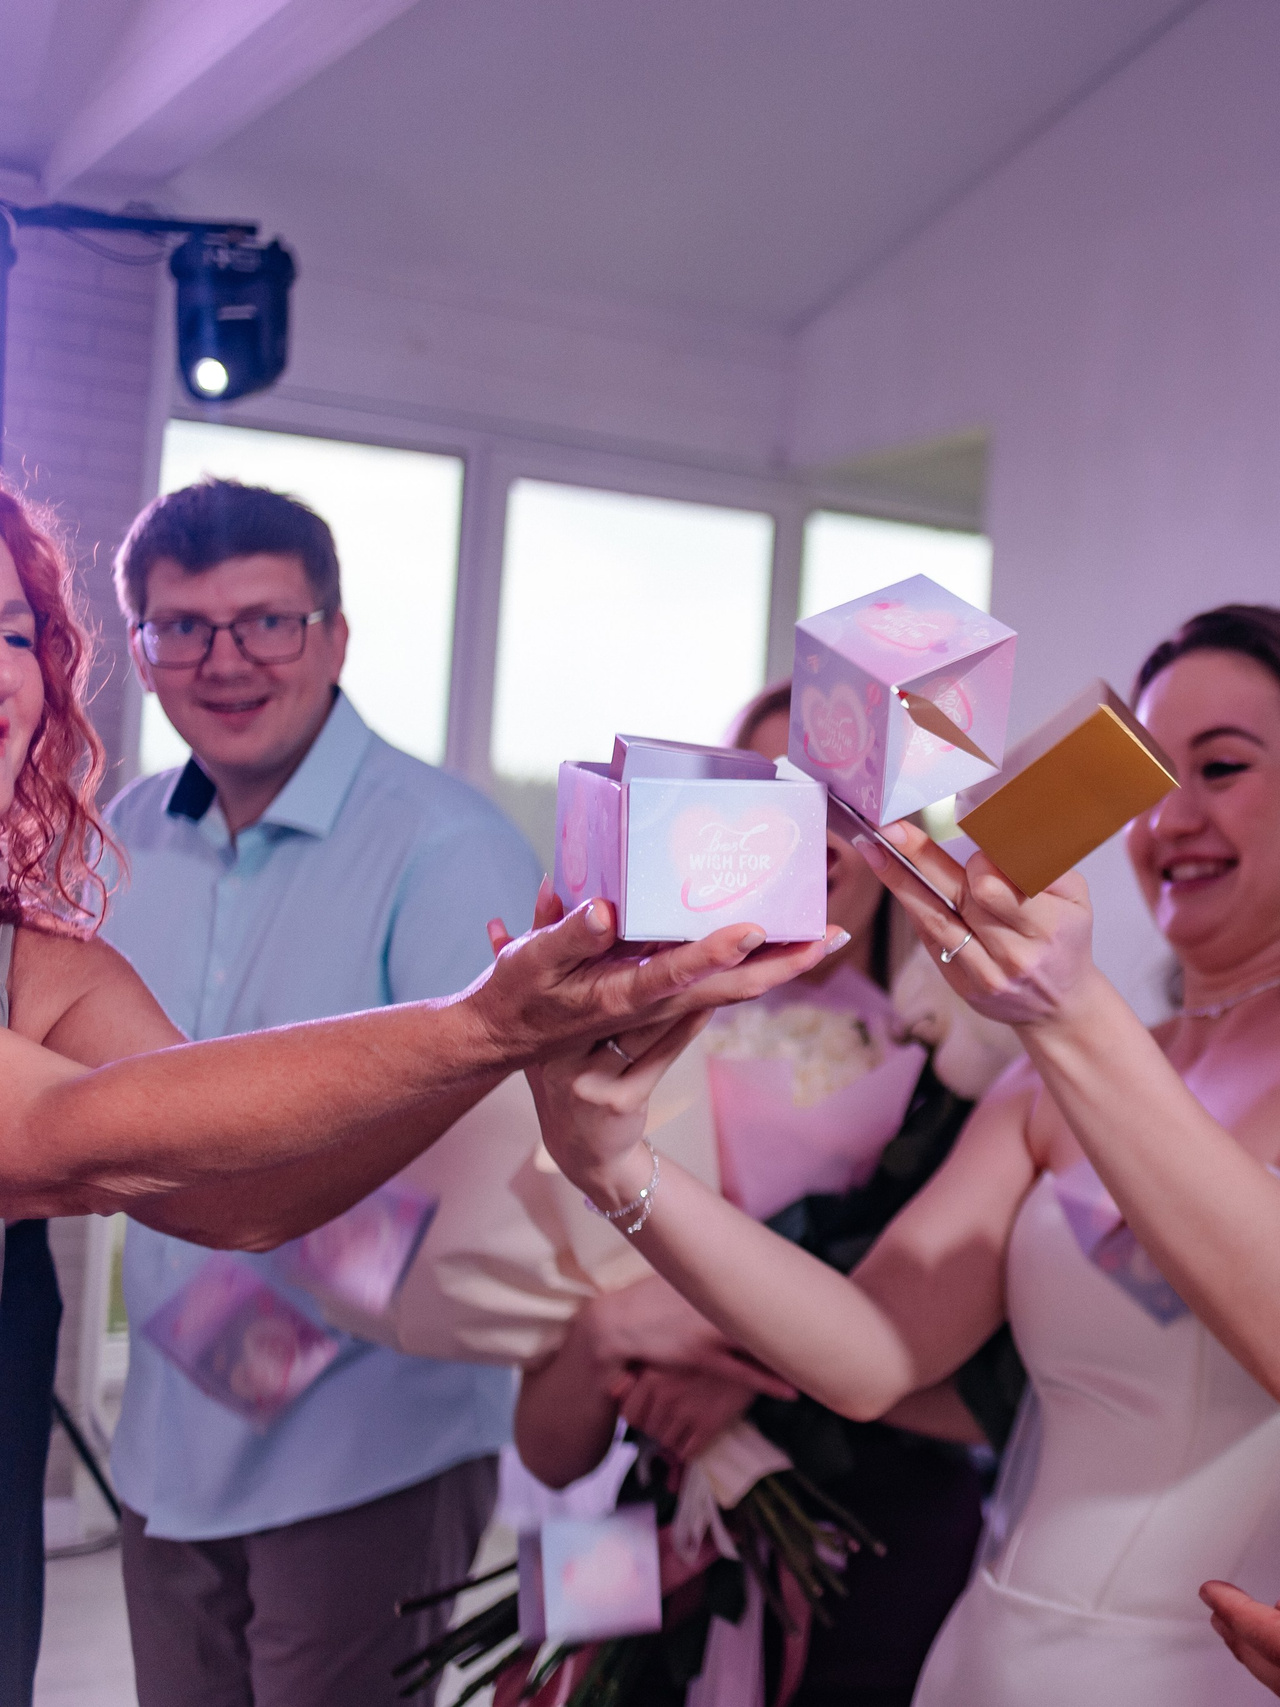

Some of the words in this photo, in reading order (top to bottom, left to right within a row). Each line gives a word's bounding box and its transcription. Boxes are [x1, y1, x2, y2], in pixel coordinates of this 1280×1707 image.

[690, 853, 733, 870] WISH
[738, 854, 771, 870] FOR
[700, 871, 748, 896] YOU
